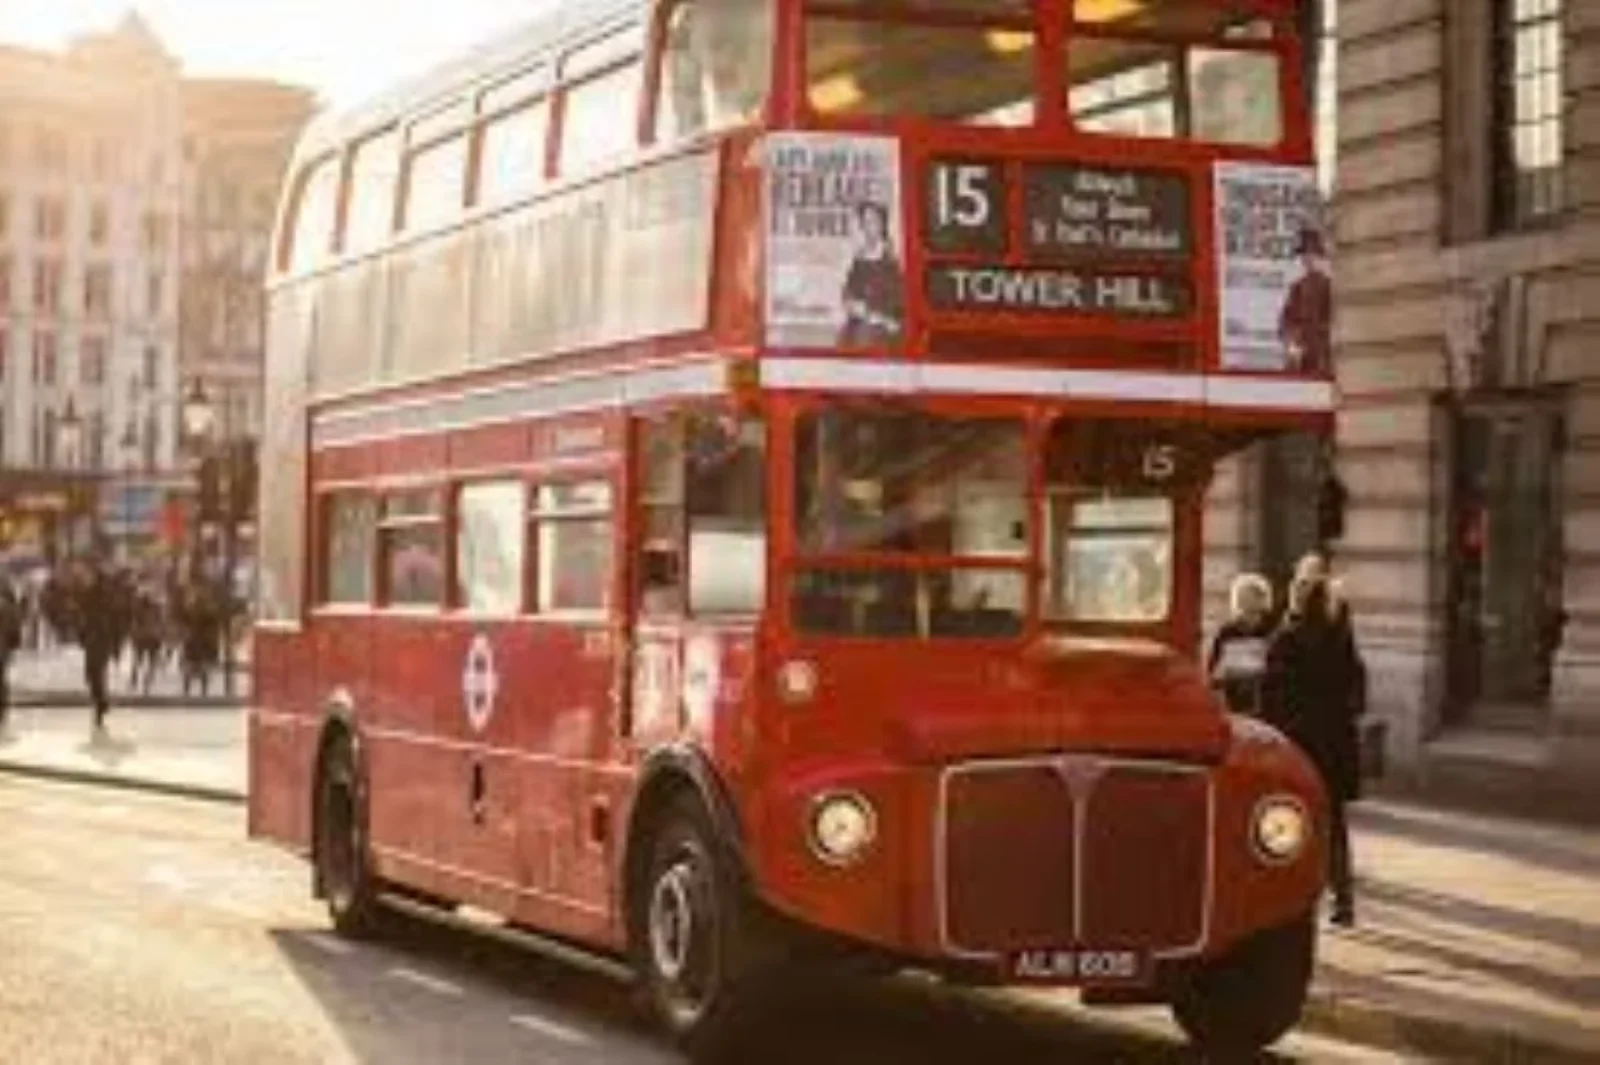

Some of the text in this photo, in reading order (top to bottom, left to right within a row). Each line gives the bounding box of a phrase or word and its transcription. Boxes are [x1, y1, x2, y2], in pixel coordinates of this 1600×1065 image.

[937, 166, 990, 227] 15
[949, 269, 1170, 312] TOWER HILL
[1143, 443, 1175, 477] 15
